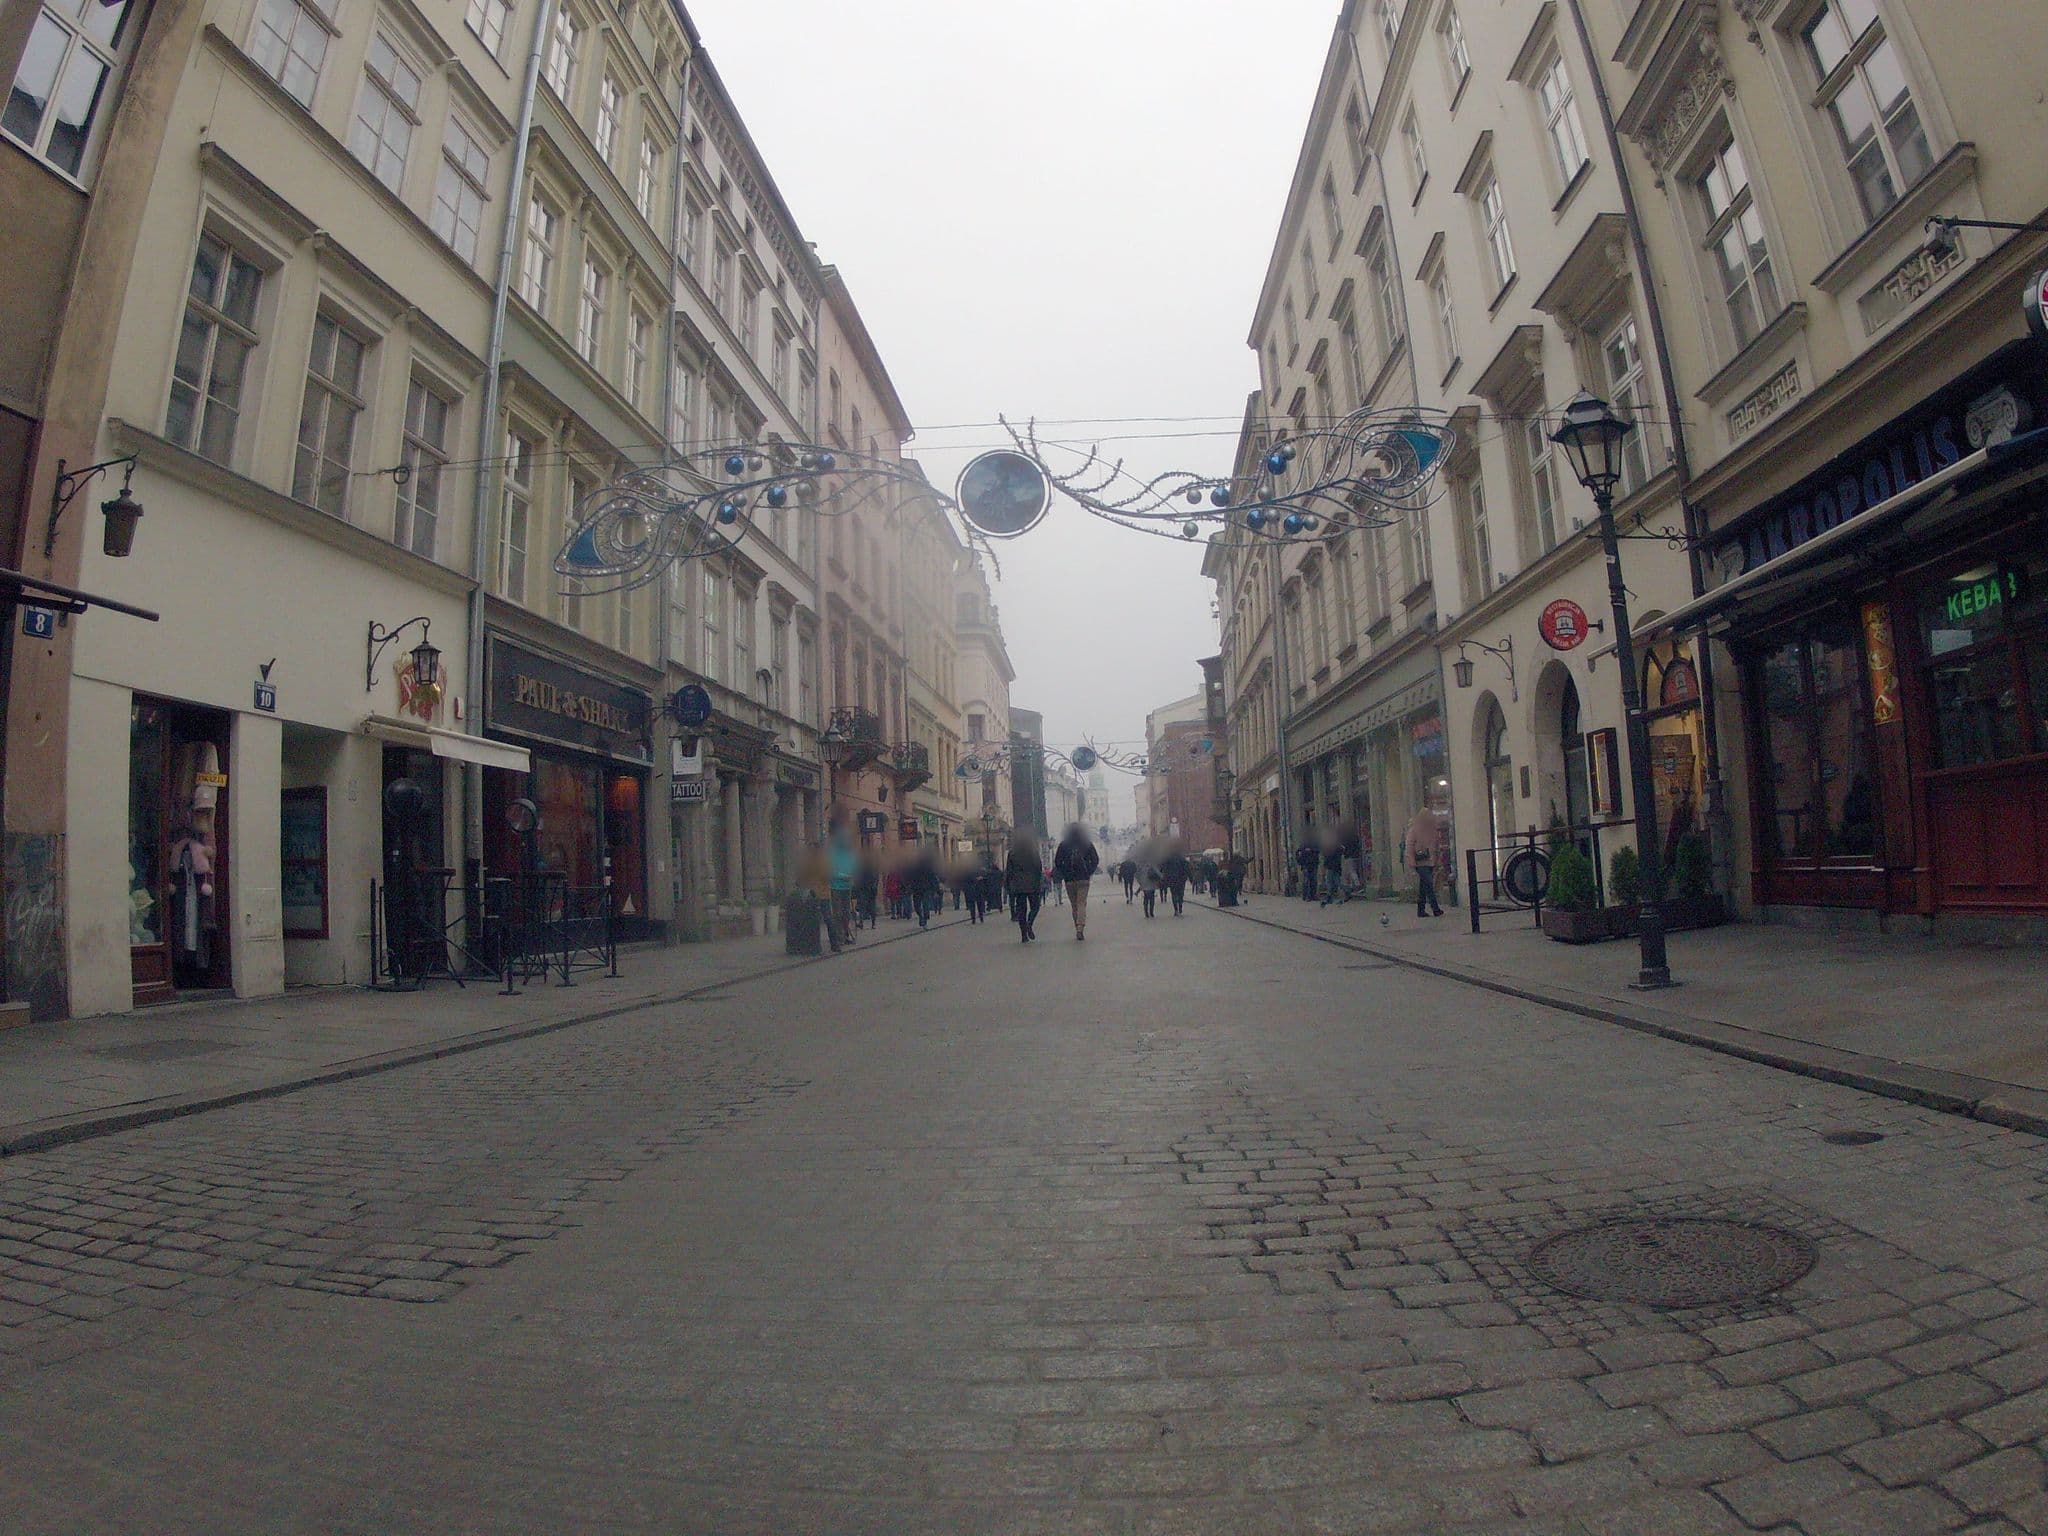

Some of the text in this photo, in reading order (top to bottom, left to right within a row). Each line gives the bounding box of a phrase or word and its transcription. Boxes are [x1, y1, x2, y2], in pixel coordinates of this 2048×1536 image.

[1748, 416, 1959, 569] AKROPOLIS
[35, 613, 45, 633] 8
[260, 691, 272, 708] 10
[515, 673, 561, 715] PAUL
[562, 690, 577, 719] &
[672, 783, 702, 797] TATTOO
